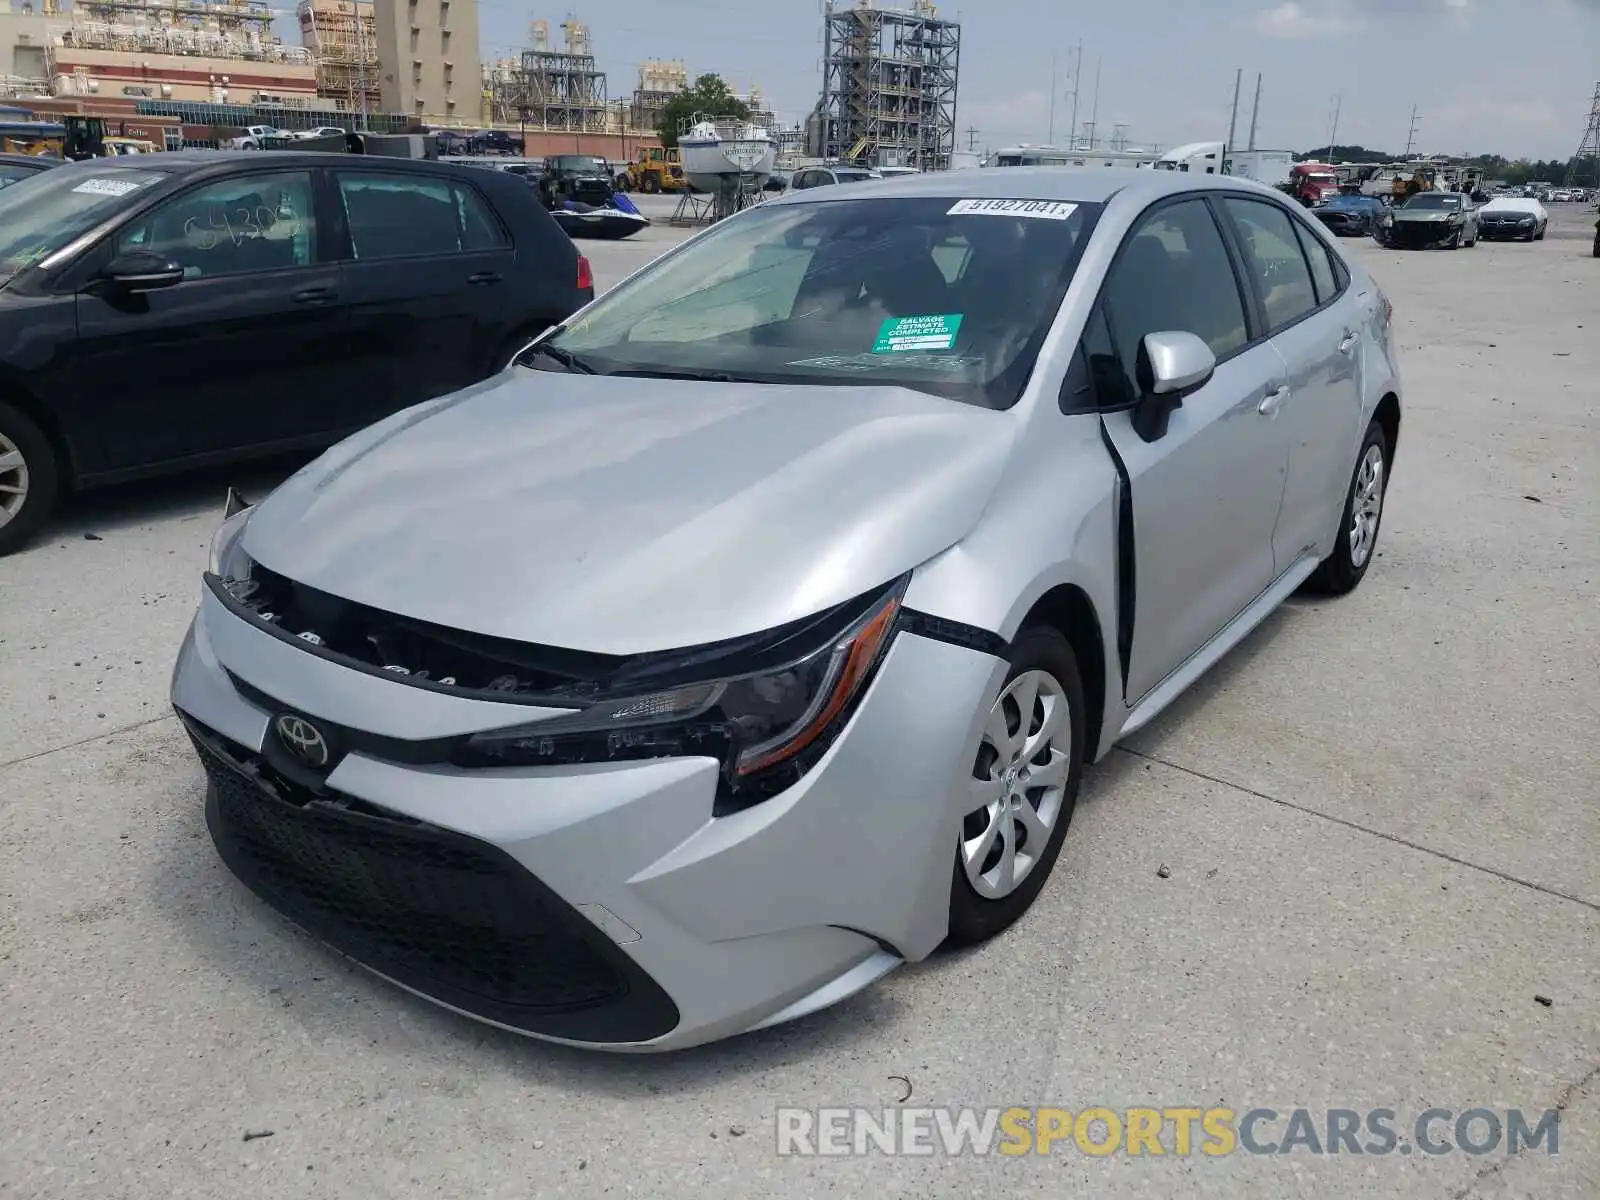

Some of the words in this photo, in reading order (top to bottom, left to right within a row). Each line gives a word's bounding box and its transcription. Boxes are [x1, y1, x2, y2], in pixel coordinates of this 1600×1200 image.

[899, 316, 944, 325] SALVAGE
[895, 322, 944, 330] ESTIMATE
[888, 327, 948, 336] COMPLETED
